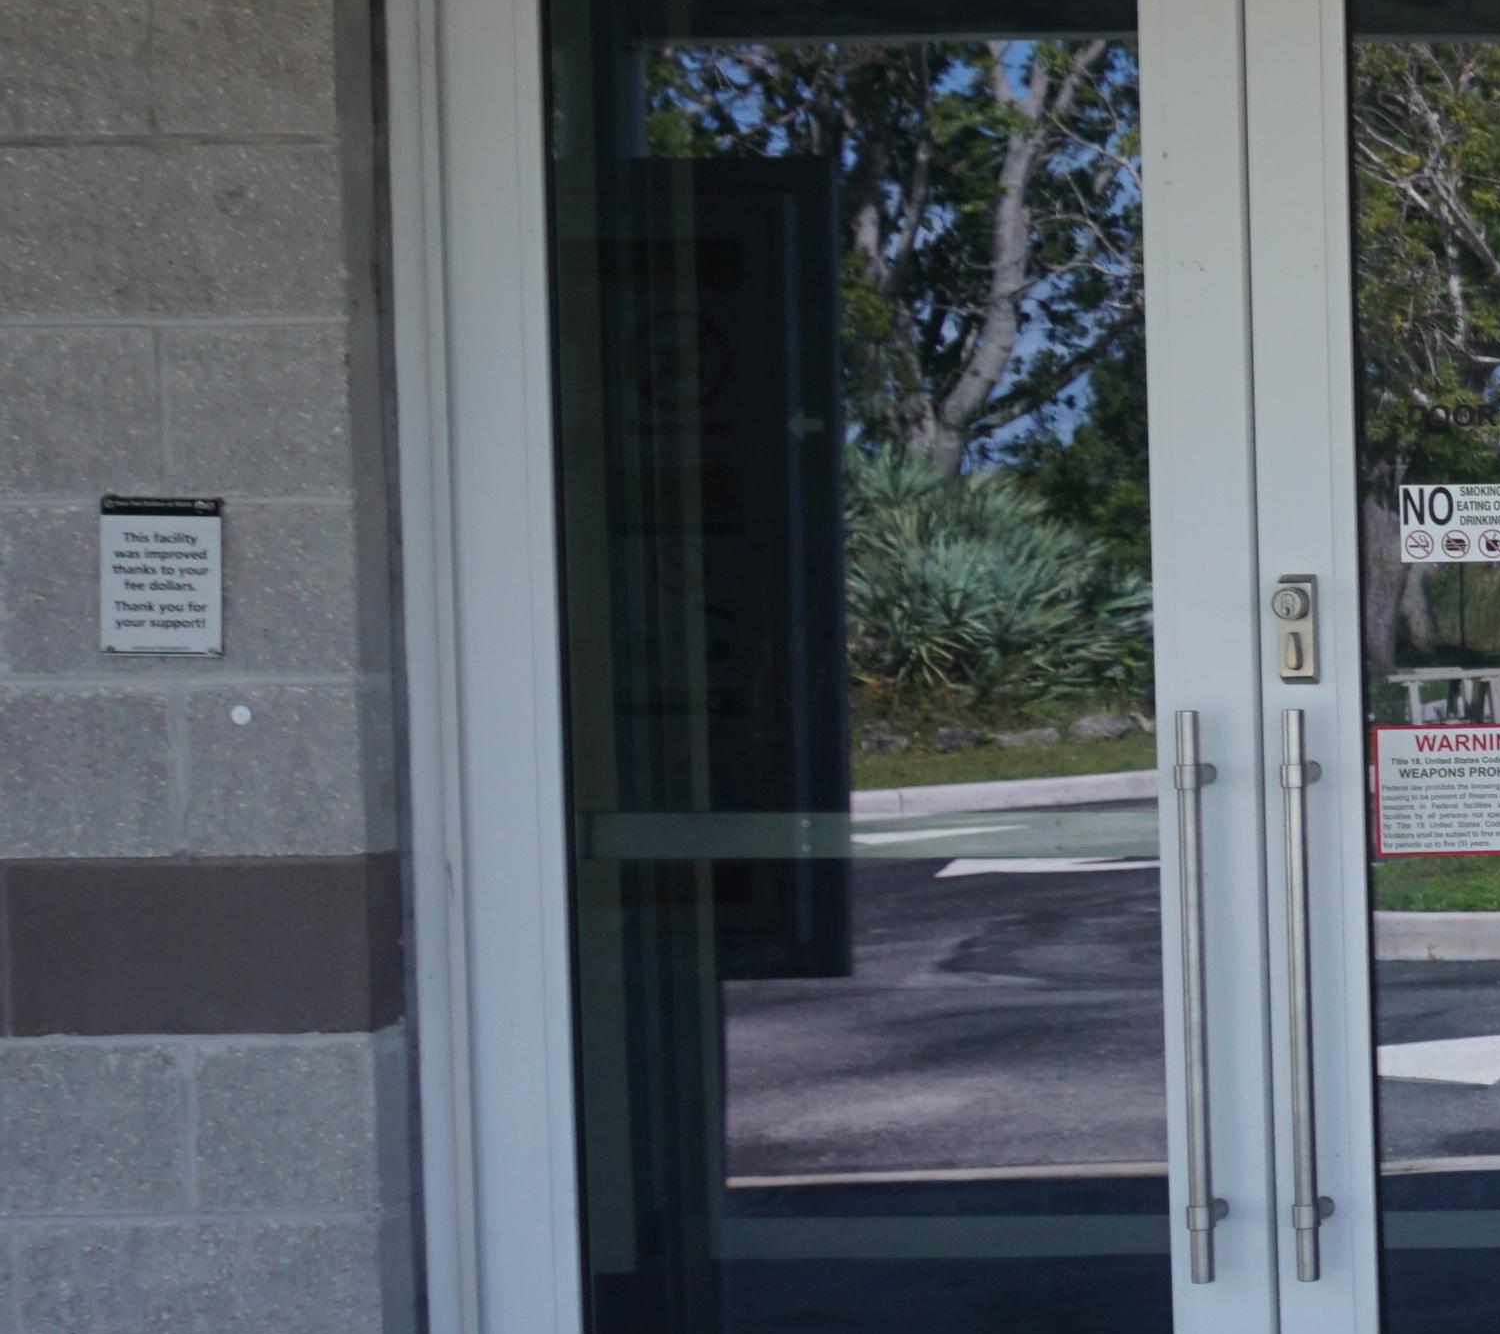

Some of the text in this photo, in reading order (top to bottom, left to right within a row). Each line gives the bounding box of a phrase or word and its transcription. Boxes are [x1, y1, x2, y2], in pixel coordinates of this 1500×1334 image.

[1407, 404, 1496, 428] DOOR
[1402, 487, 1453, 526] NO
[1456, 501, 1492, 512] EATING
[123, 532, 198, 546] This facility
[114, 549, 207, 562] was improved
[112, 565, 208, 577] thanks to your
[124, 581, 197, 591] fee dollars.
[114, 601, 207, 614] Thank you for
[115, 619, 206, 630] your support!
[1400, 768, 1465, 778] WEAPONS
